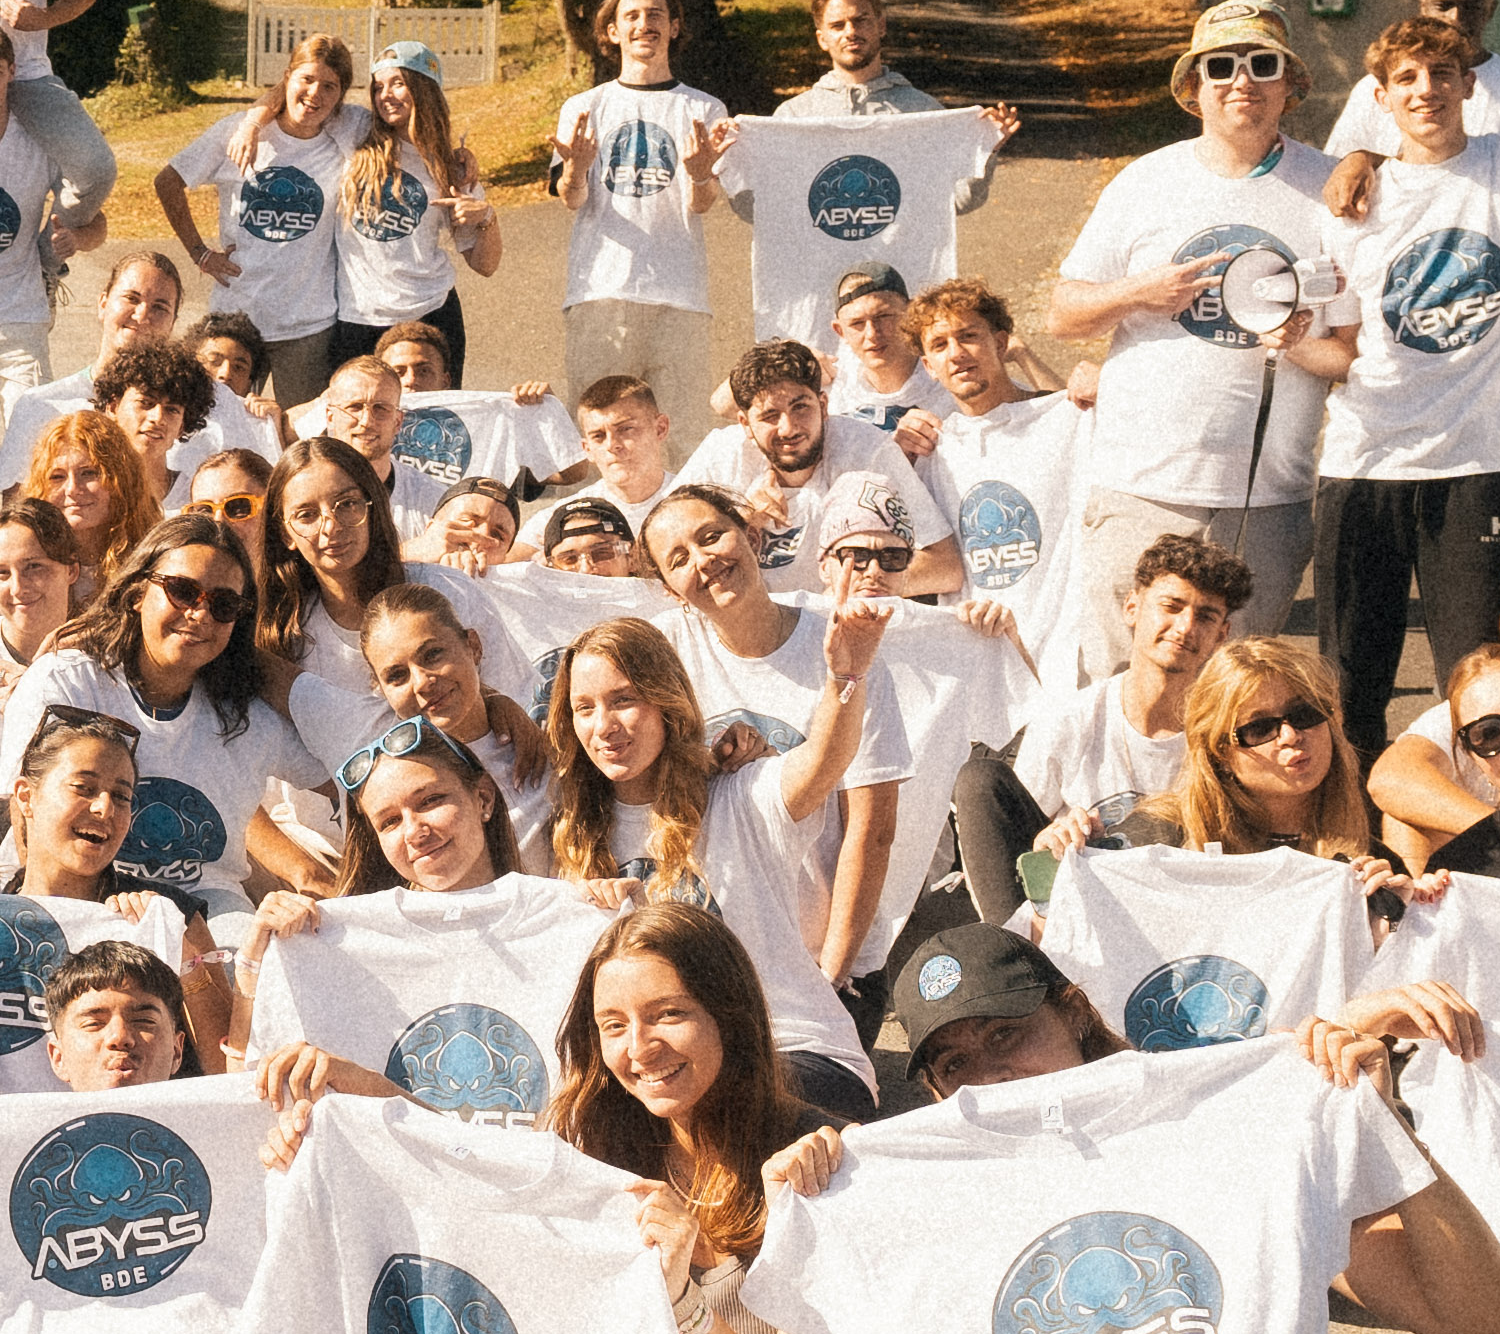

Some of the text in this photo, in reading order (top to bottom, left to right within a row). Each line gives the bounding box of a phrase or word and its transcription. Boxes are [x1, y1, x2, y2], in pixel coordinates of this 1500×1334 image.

[601, 167, 671, 187] ABYSS
[240, 209, 316, 231] ABYSS
[814, 207, 895, 227] ABYSS
[843, 228, 864, 237] BDE
[1214, 329, 1248, 345] BDE
[34, 1211, 205, 1279] ABYSS
[101, 1266, 147, 1290] BDE
